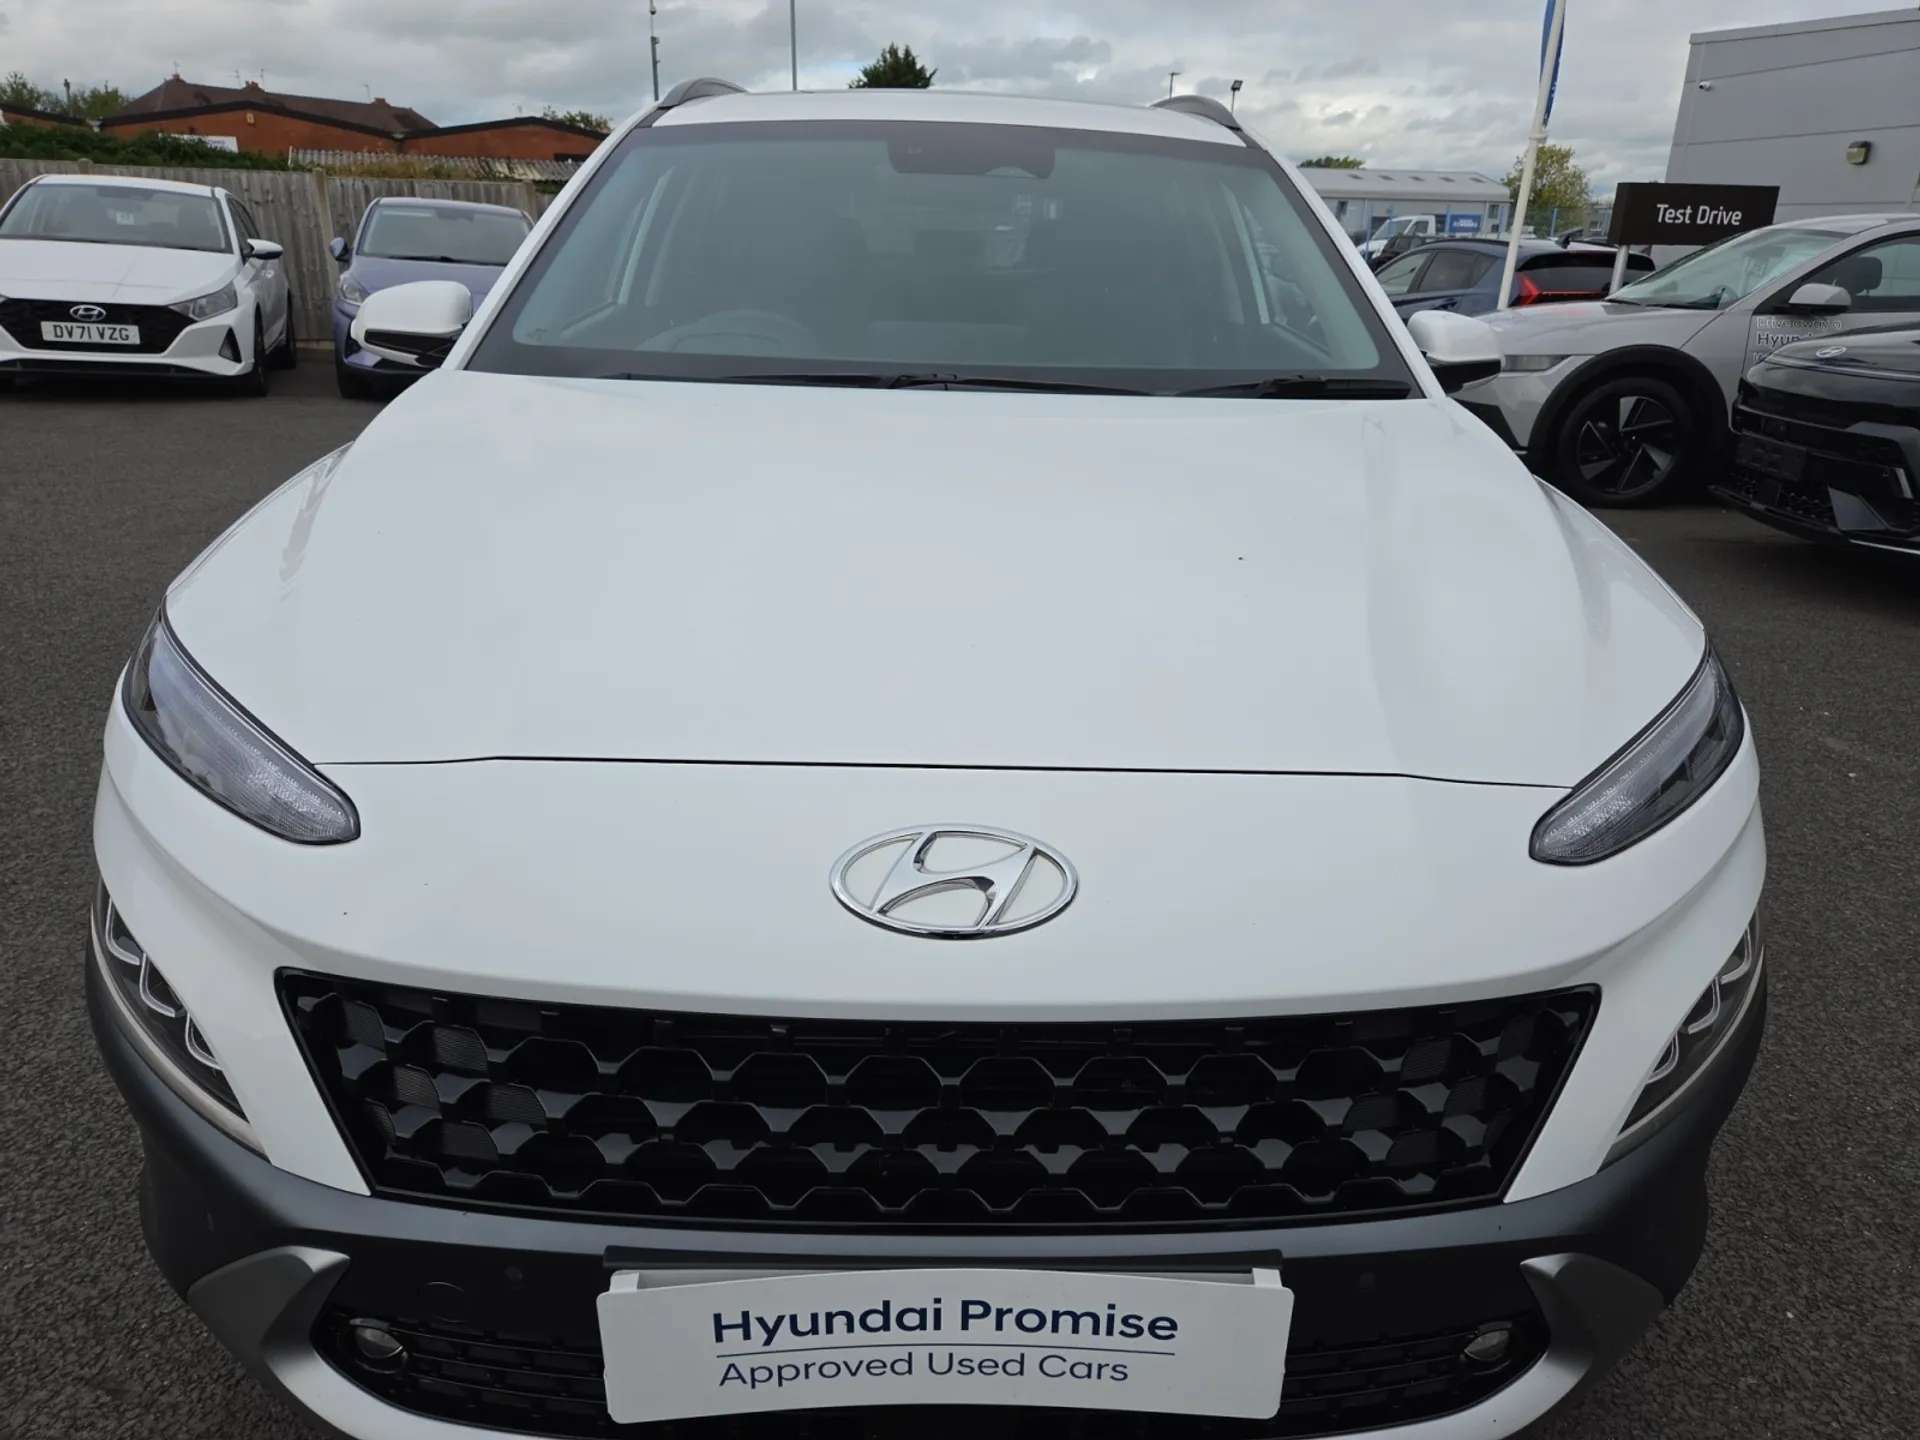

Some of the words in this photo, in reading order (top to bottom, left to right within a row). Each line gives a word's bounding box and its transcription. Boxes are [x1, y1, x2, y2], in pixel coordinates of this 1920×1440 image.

[1656, 204, 1692, 224] Test
[1696, 205, 1742, 225] Drive
[52, 324, 92, 340] DV71
[96, 326, 130, 341] VZG
[713, 1297, 942, 1347] Hyundai
[960, 1299, 1178, 1341] Promise
[719, 1351, 913, 1389] Approved
[928, 1352, 1025, 1377] Used
[1038, 1354, 1129, 1381] Cars
